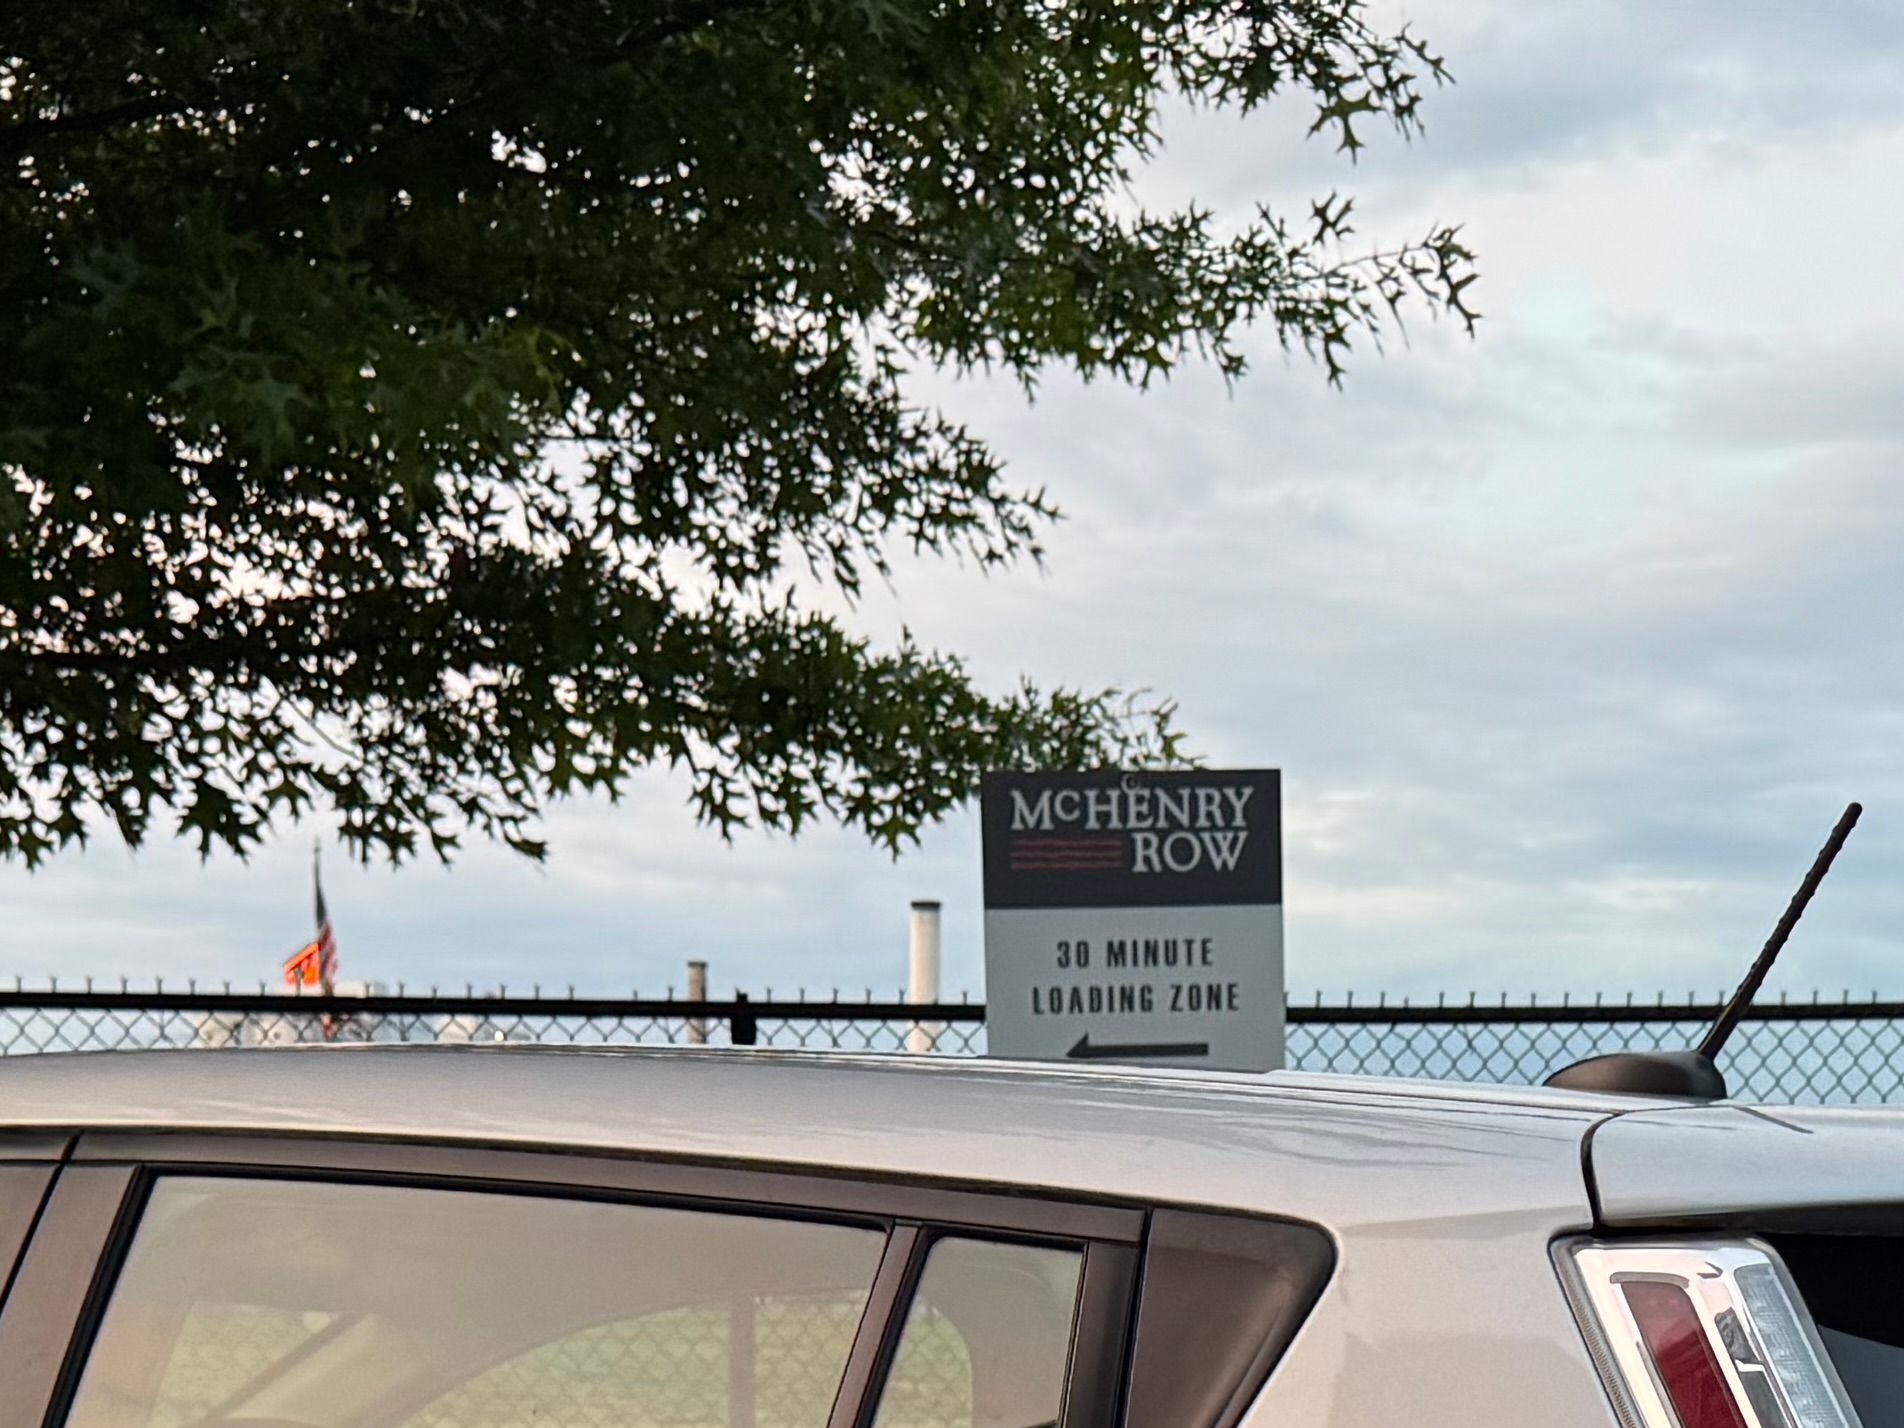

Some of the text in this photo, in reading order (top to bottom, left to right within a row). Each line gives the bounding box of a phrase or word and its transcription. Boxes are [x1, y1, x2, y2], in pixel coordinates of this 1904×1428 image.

[1131, 831, 1248, 872] ROW
[1057, 938, 1214, 968] 30 MINUTE
[1032, 983, 1240, 1015] LOADING ZONE
